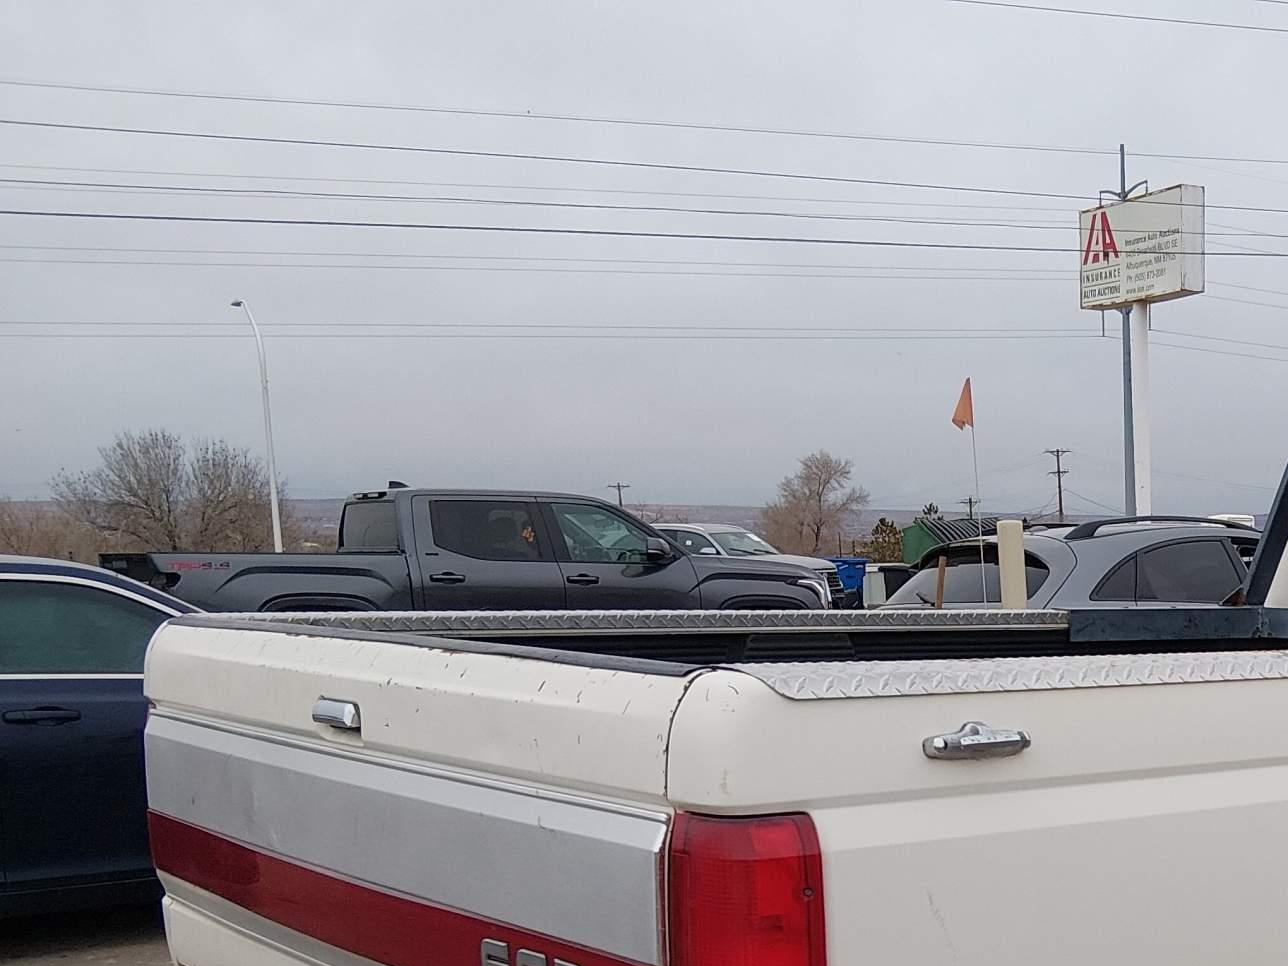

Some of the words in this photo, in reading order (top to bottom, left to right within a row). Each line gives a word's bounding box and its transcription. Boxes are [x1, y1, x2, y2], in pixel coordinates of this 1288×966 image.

[1148, 232, 1158, 240] Auto
[1083, 268, 1120, 285] INSURANCE
[1083, 289, 1097, 300] AUTO
[1097, 285, 1120, 298] AUCTIONS
